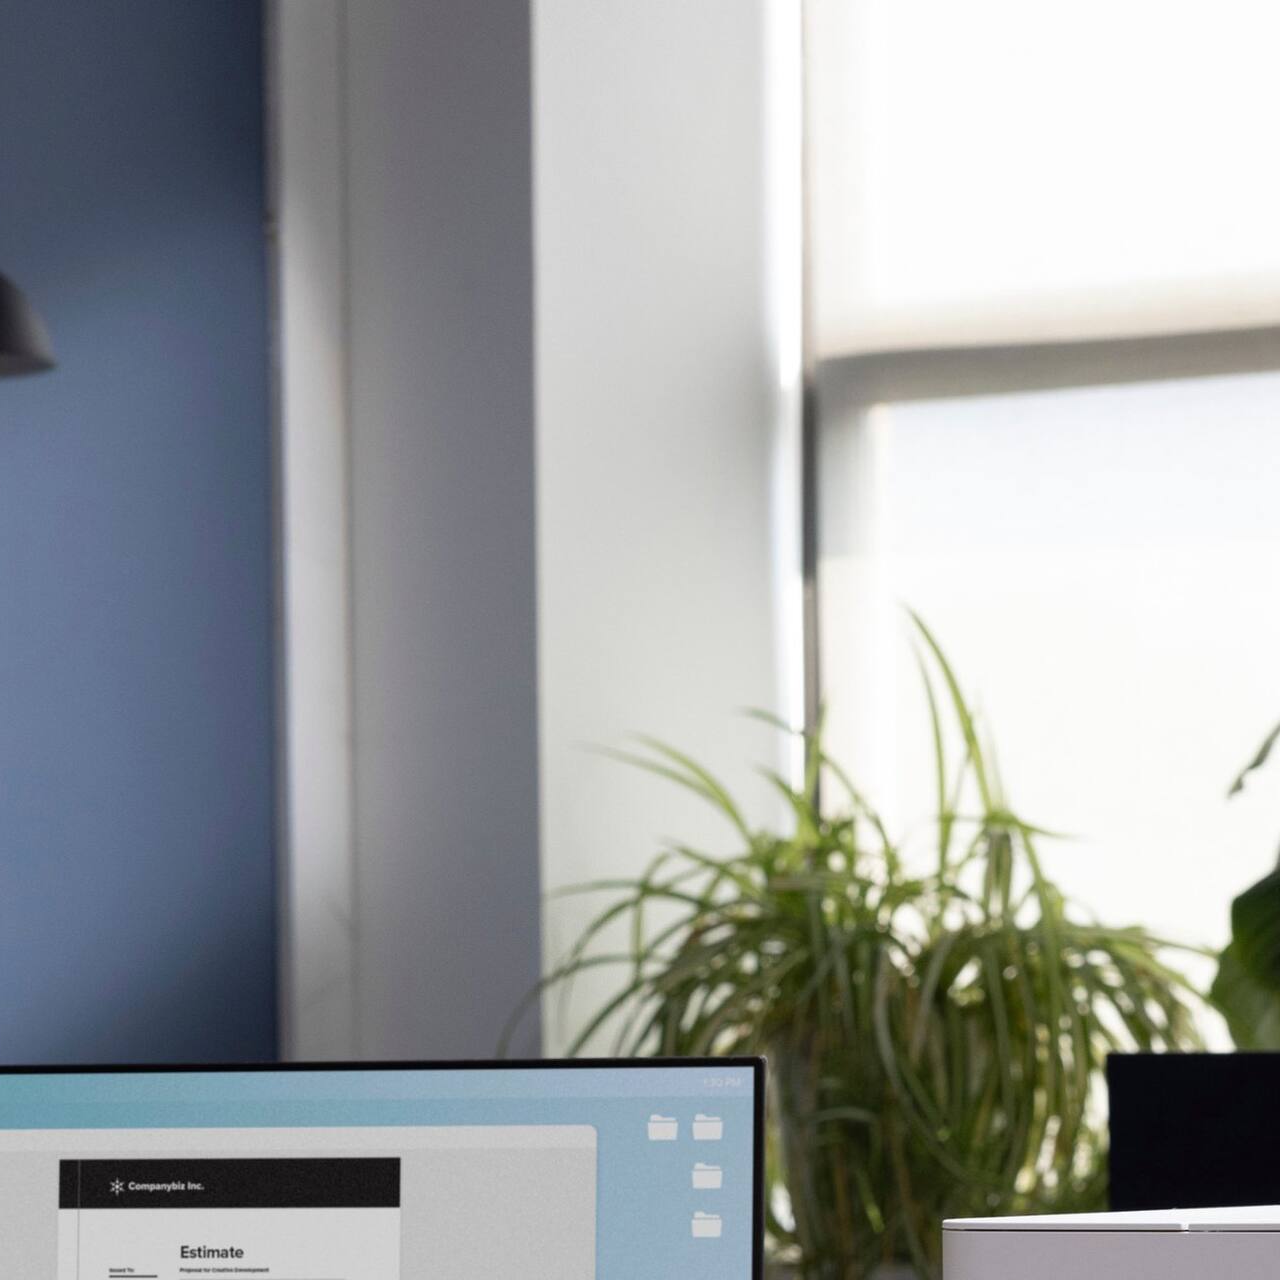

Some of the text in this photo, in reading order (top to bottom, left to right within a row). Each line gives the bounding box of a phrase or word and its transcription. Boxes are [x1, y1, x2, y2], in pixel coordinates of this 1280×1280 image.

[128, 1181, 204, 1192] Companybiz Inc.
[181, 1246, 244, 1258] Estimate
